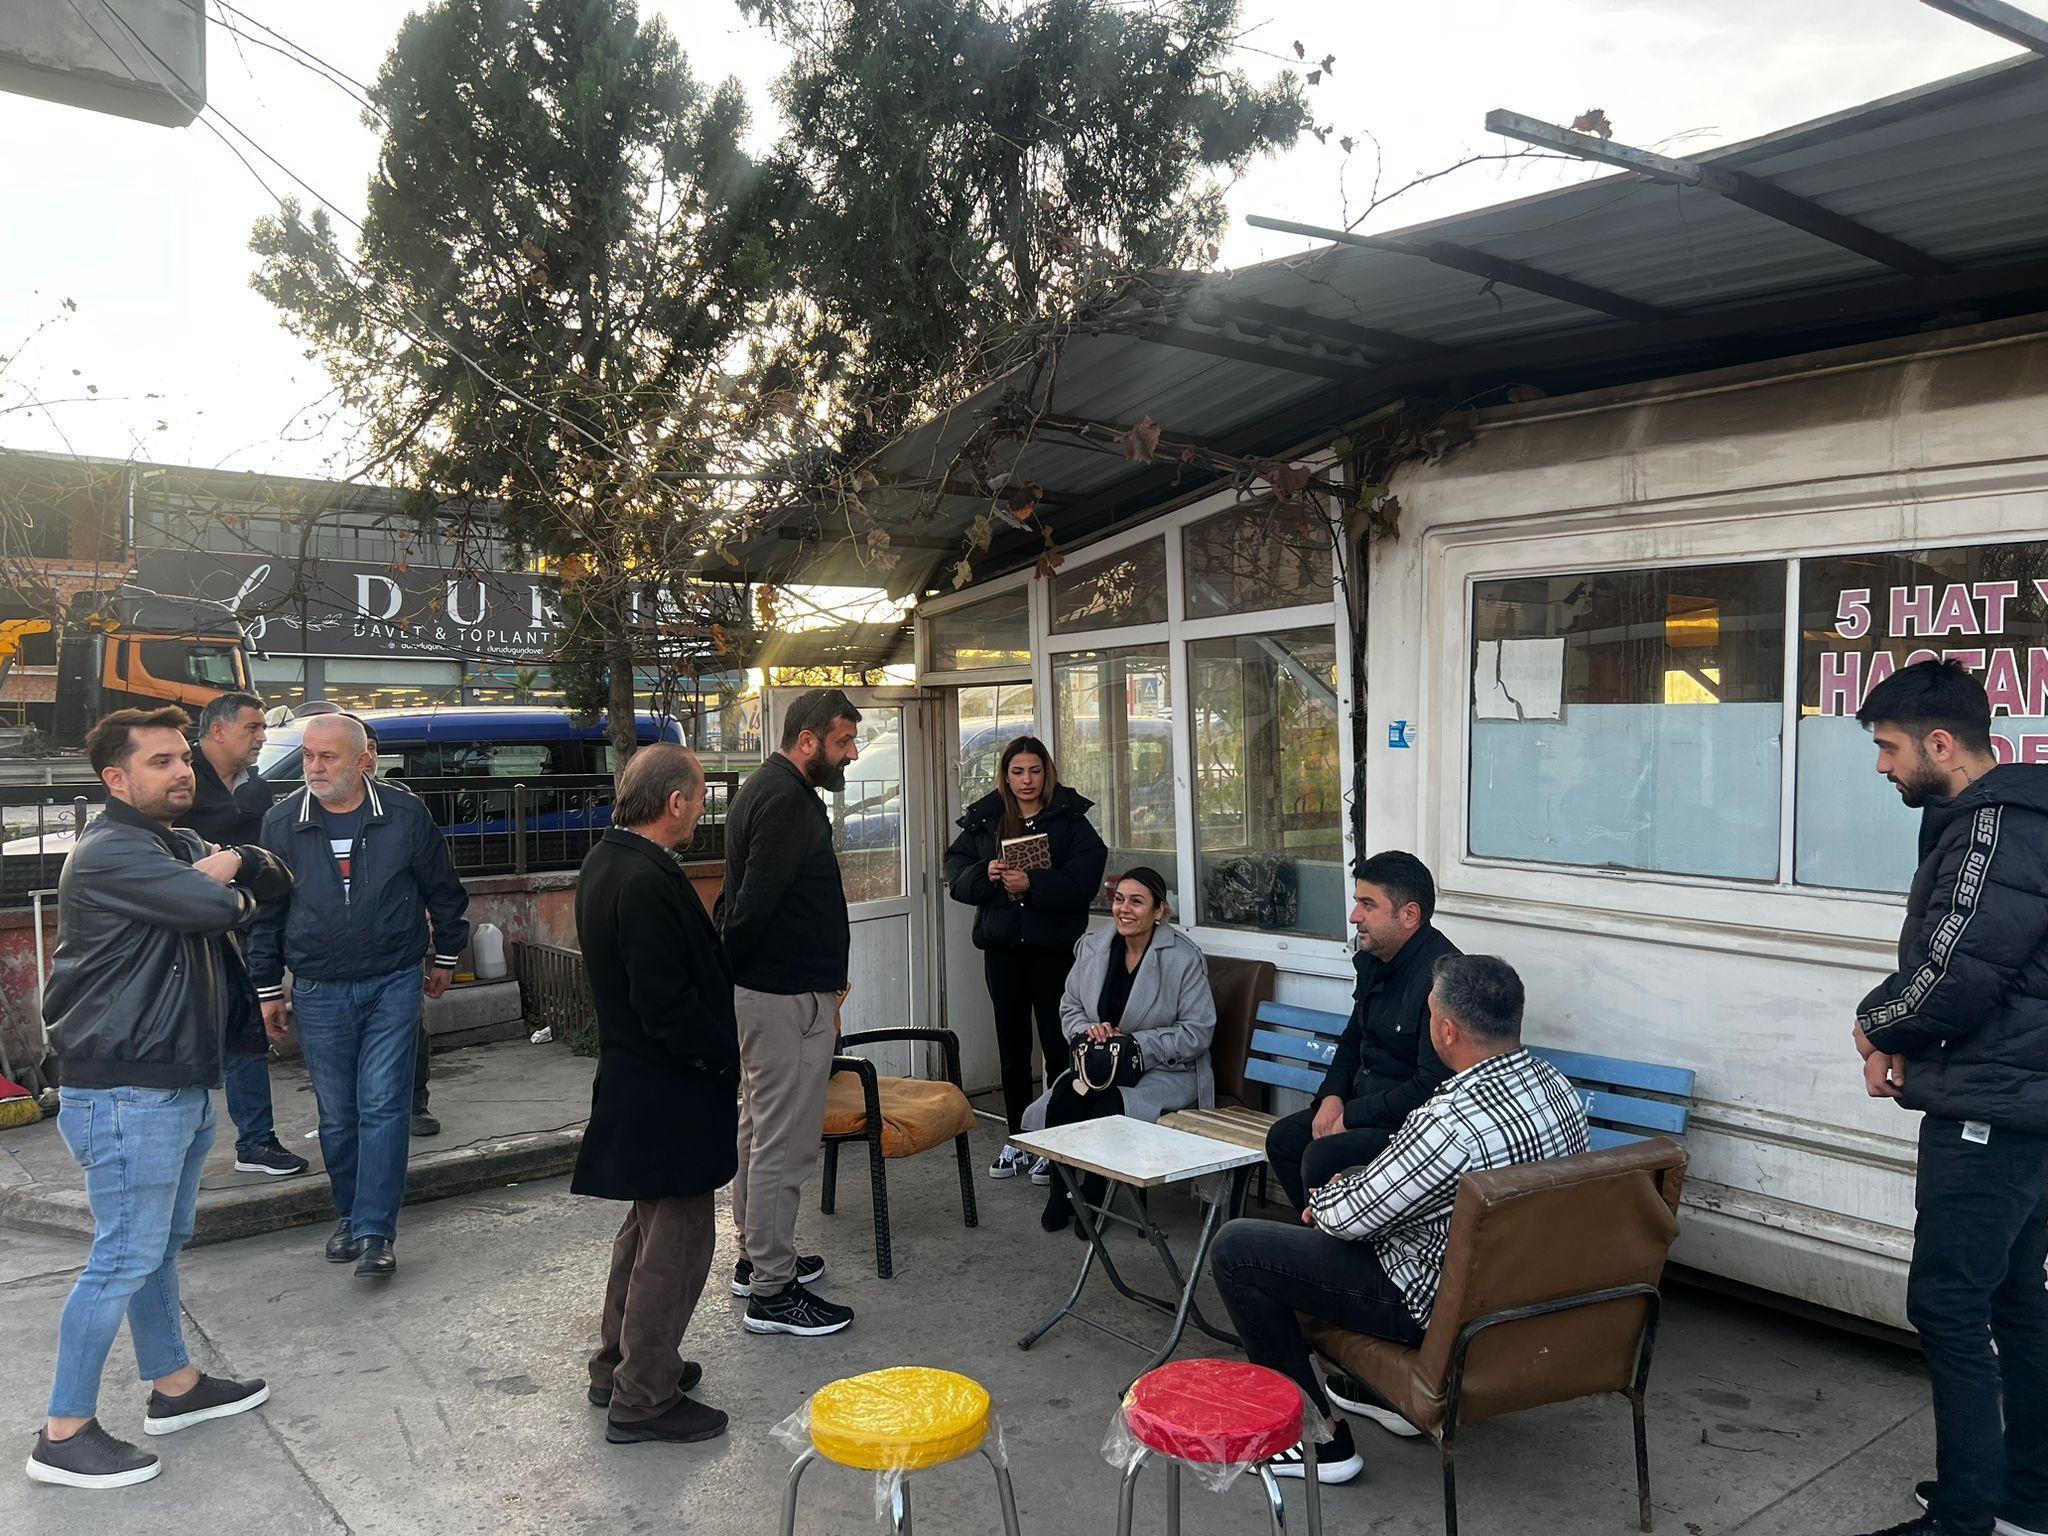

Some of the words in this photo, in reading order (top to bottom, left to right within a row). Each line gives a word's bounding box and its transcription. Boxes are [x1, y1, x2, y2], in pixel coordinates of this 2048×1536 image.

[435, 626, 446, 640] &
[1834, 588, 1871, 639] 5
[1889, 580, 2018, 637] HAT
[1977, 807, 1996, 846] GUESS
[1958, 851, 1986, 909] GUESS
[1931, 913, 1964, 967] GUESS
[1904, 967, 1936, 1009] GUES
